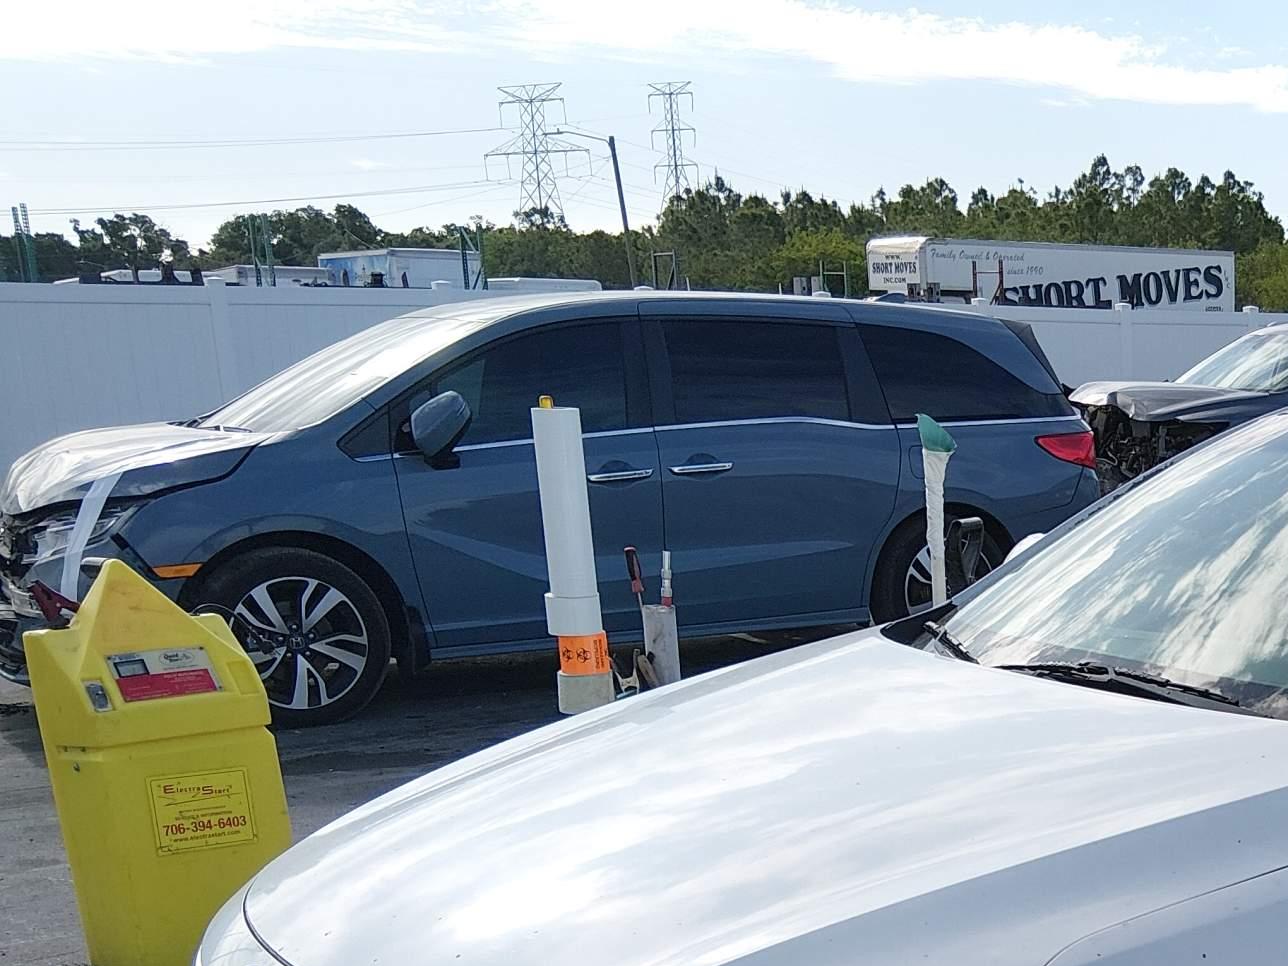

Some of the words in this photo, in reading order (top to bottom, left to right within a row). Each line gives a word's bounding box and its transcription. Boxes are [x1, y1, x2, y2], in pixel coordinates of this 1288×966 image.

[872, 261, 894, 275] SHORT
[894, 261, 917, 275] MOVES
[1026, 266, 1045, 277] 1990
[1003, 277, 1113, 310] SHORT
[1116, 264, 1224, 310] MOVES
[162, 815, 247, 837] 706-394-6403
